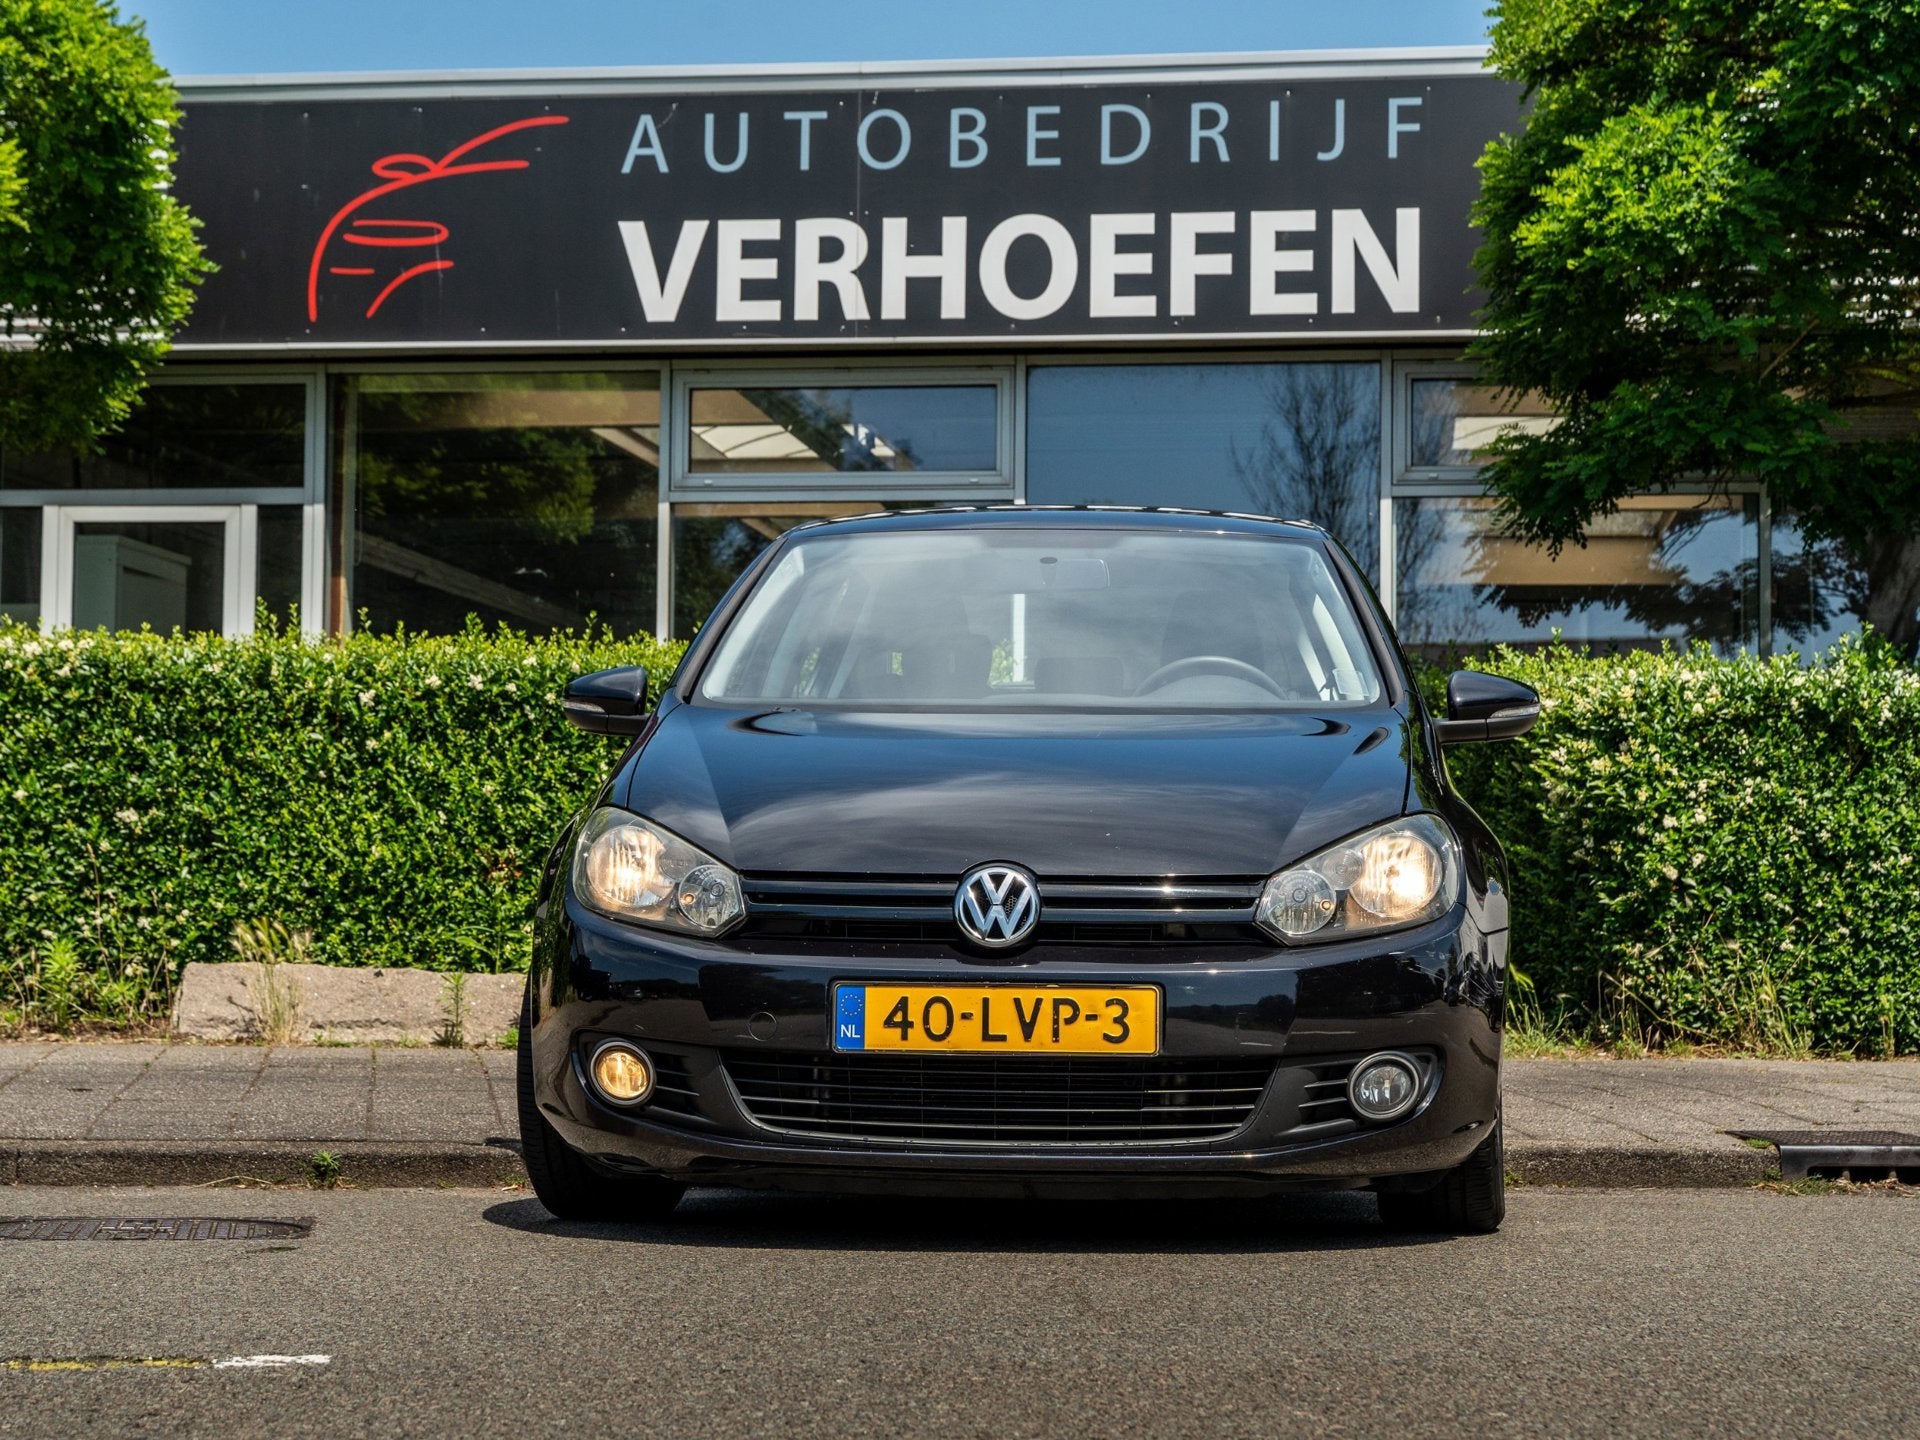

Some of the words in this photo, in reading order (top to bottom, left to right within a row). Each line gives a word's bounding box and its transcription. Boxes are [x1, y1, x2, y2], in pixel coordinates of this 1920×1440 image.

[620, 96, 1423, 174] AUTOBEDRIJF
[617, 206, 1421, 323] VERHOEFEN
[840, 1024, 861, 1038] NL
[883, 996, 1130, 1044] 40-LVP-3
